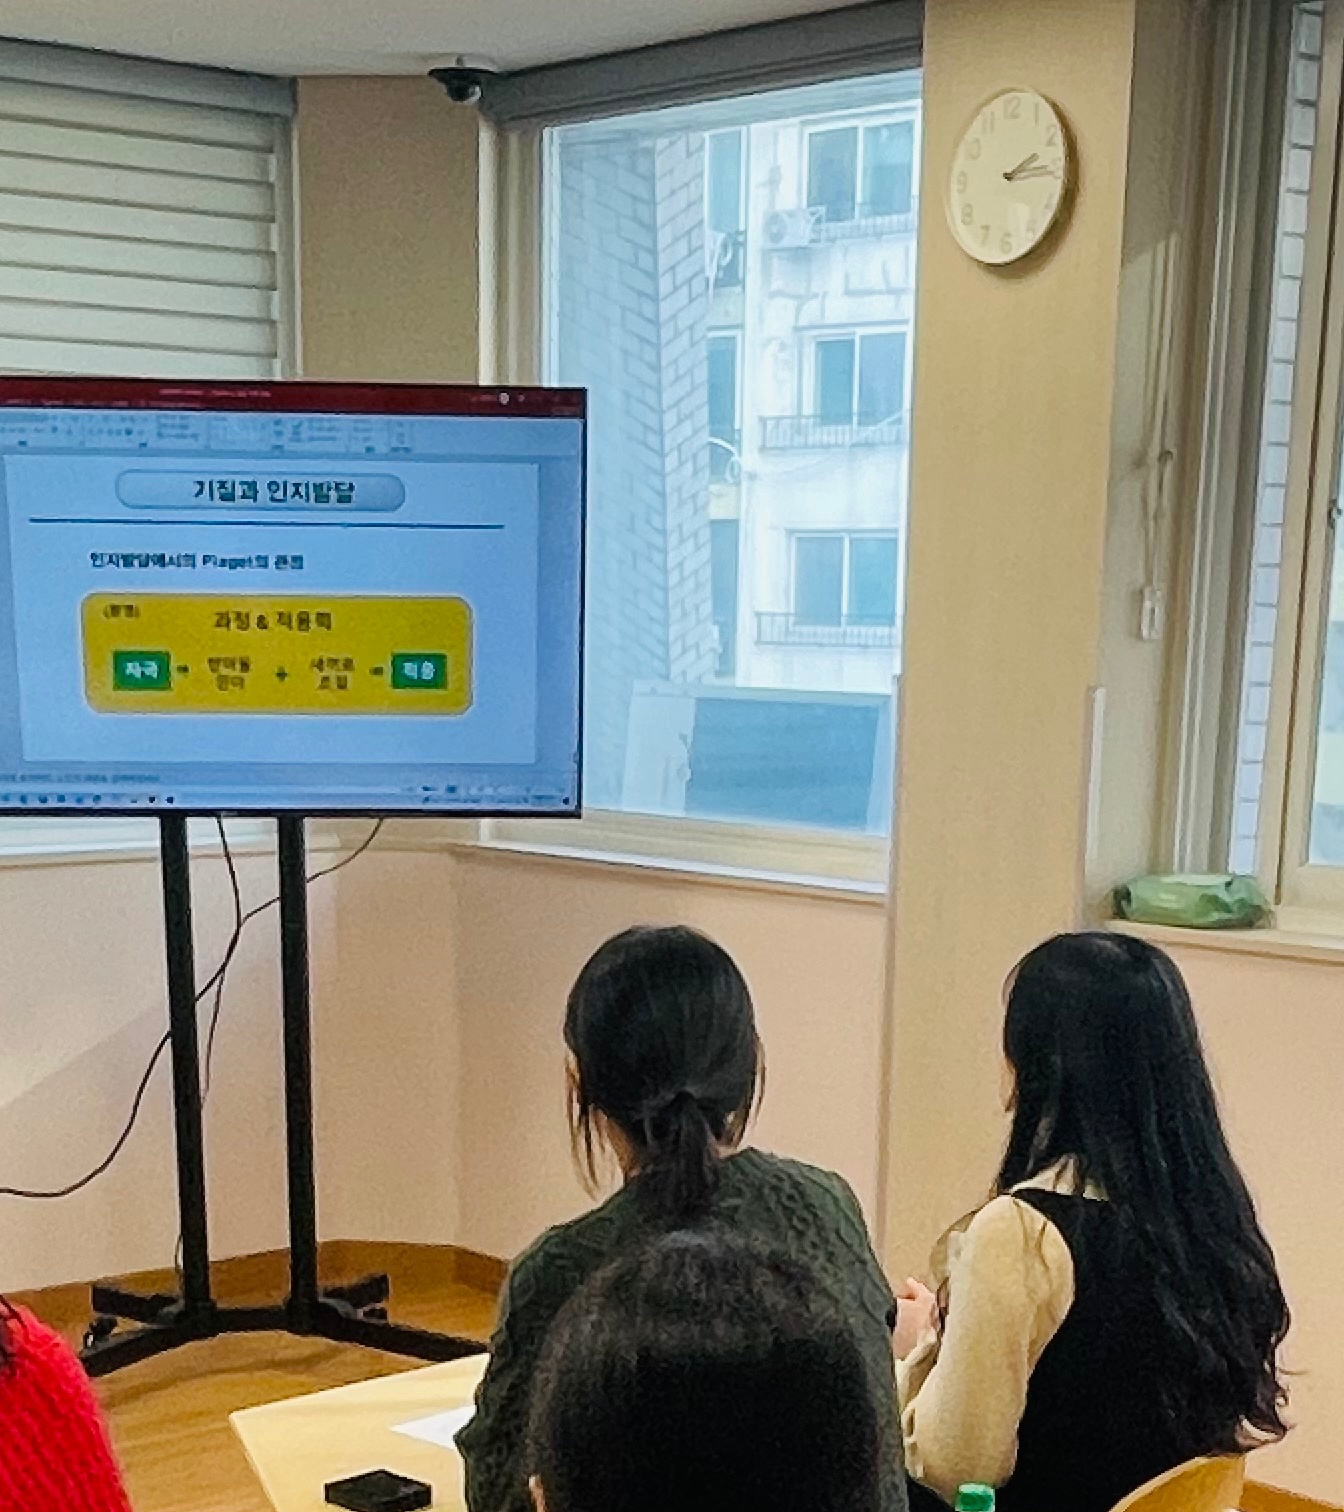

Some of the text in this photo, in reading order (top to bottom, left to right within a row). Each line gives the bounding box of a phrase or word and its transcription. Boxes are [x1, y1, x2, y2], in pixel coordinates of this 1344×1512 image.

[1003, 97, 1022, 119] 12
[1033, 103, 1040, 127] 1
[982, 111, 996, 135] 11
[1046, 124, 1058, 147] 2
[957, 170, 968, 194] 9
[961, 202, 974, 226] 8
[979, 224, 991, 247] 7
[1000, 232, 1013, 255] 6
[193, 478, 356, 504] 기질과 인지발달
[255, 613, 270, 631] &
